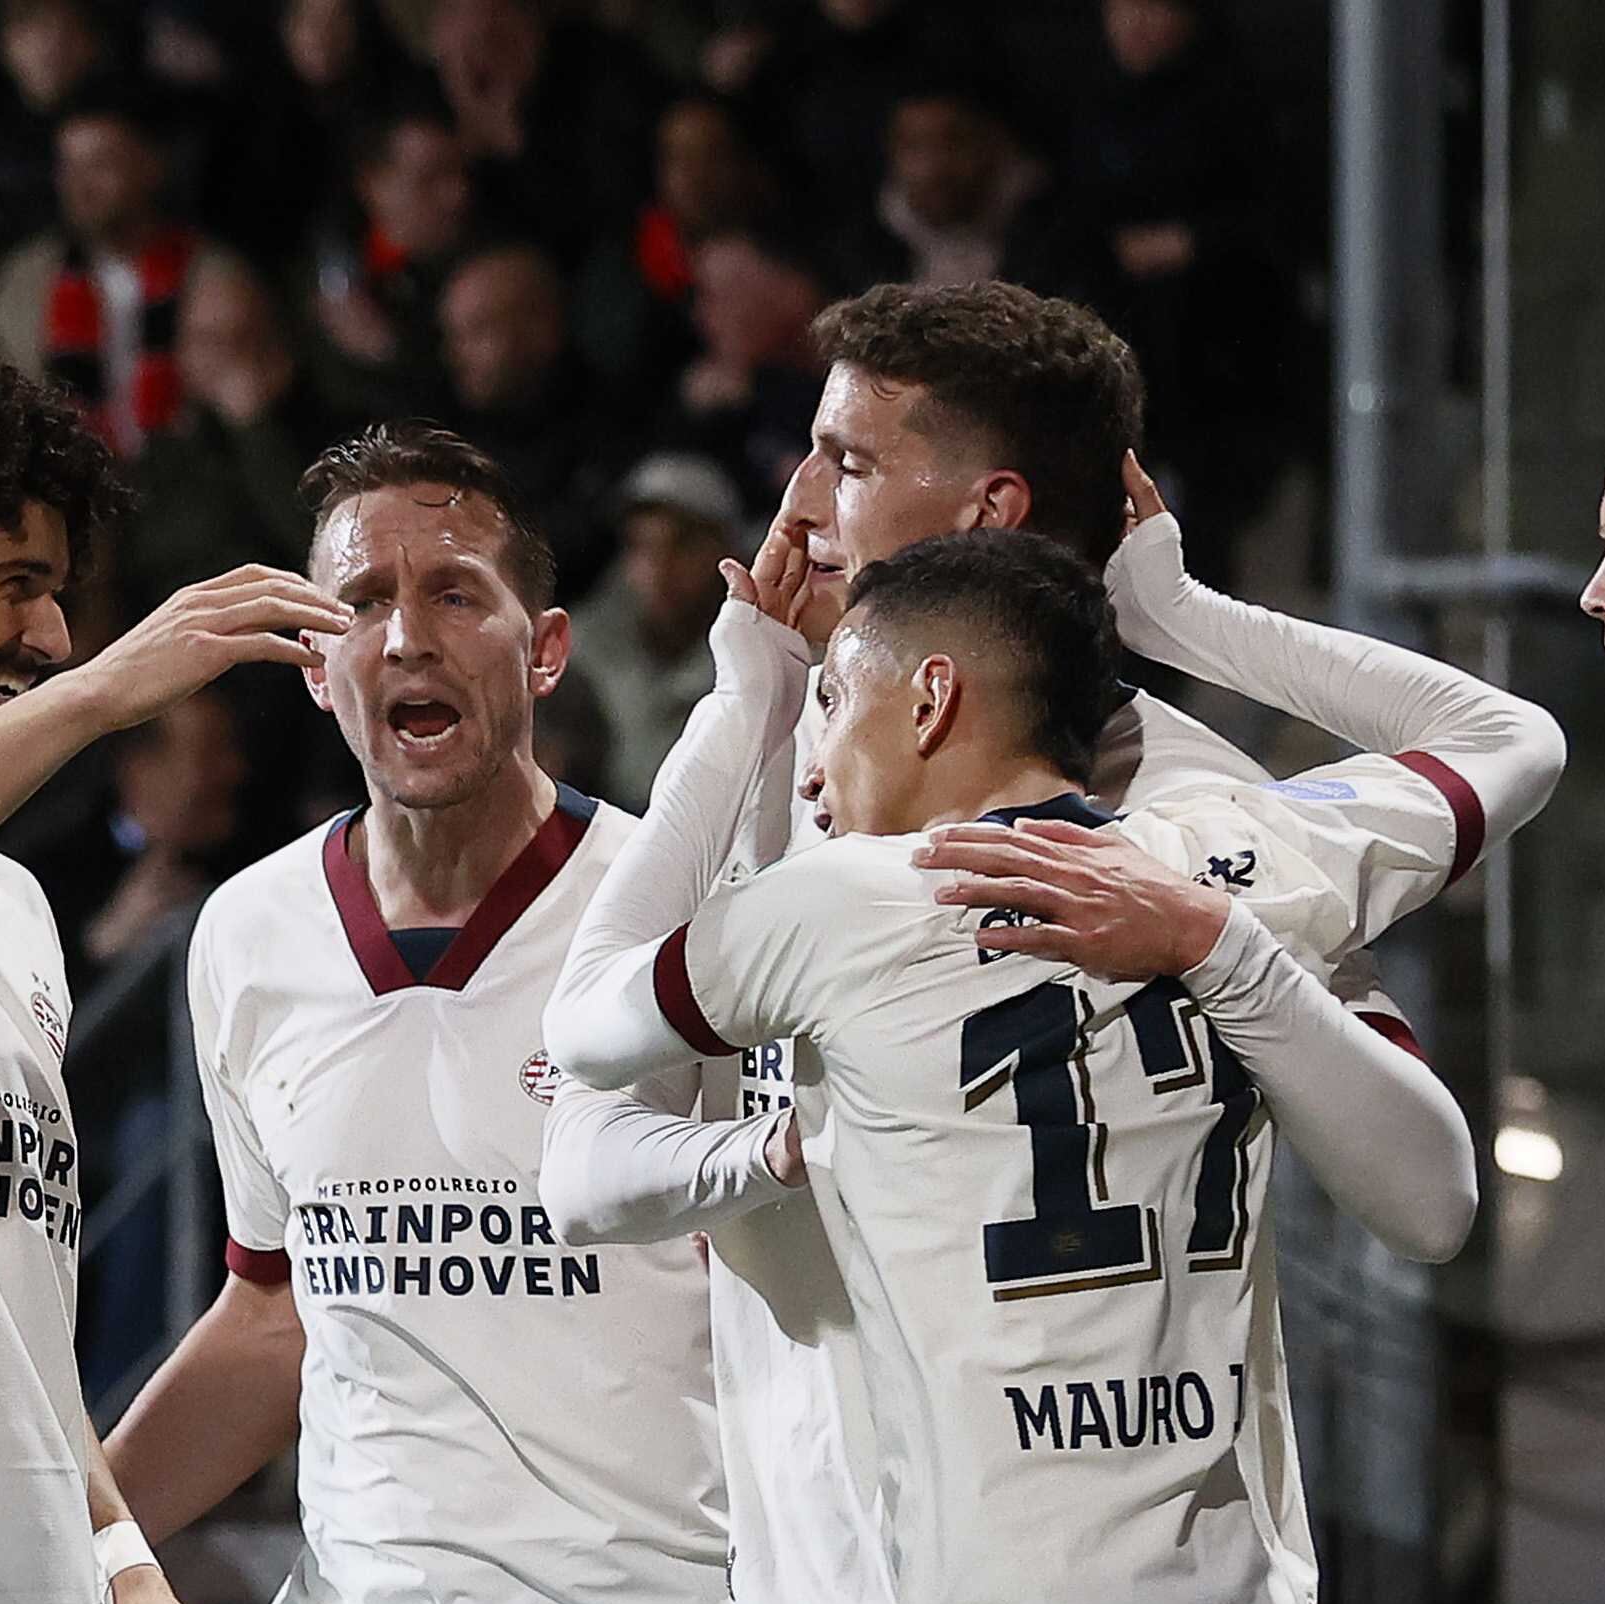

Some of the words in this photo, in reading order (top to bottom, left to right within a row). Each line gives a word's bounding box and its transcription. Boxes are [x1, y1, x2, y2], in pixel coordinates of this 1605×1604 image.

[958, 974, 1258, 1303] 17
[317, 1177, 518, 1199] METROPOOLREGIO
[298, 1203, 558, 1246] BRAINPOR
[304, 1254, 602, 1297] EINDHOVEN
[1003, 1370, 1215, 1451] MAURO
